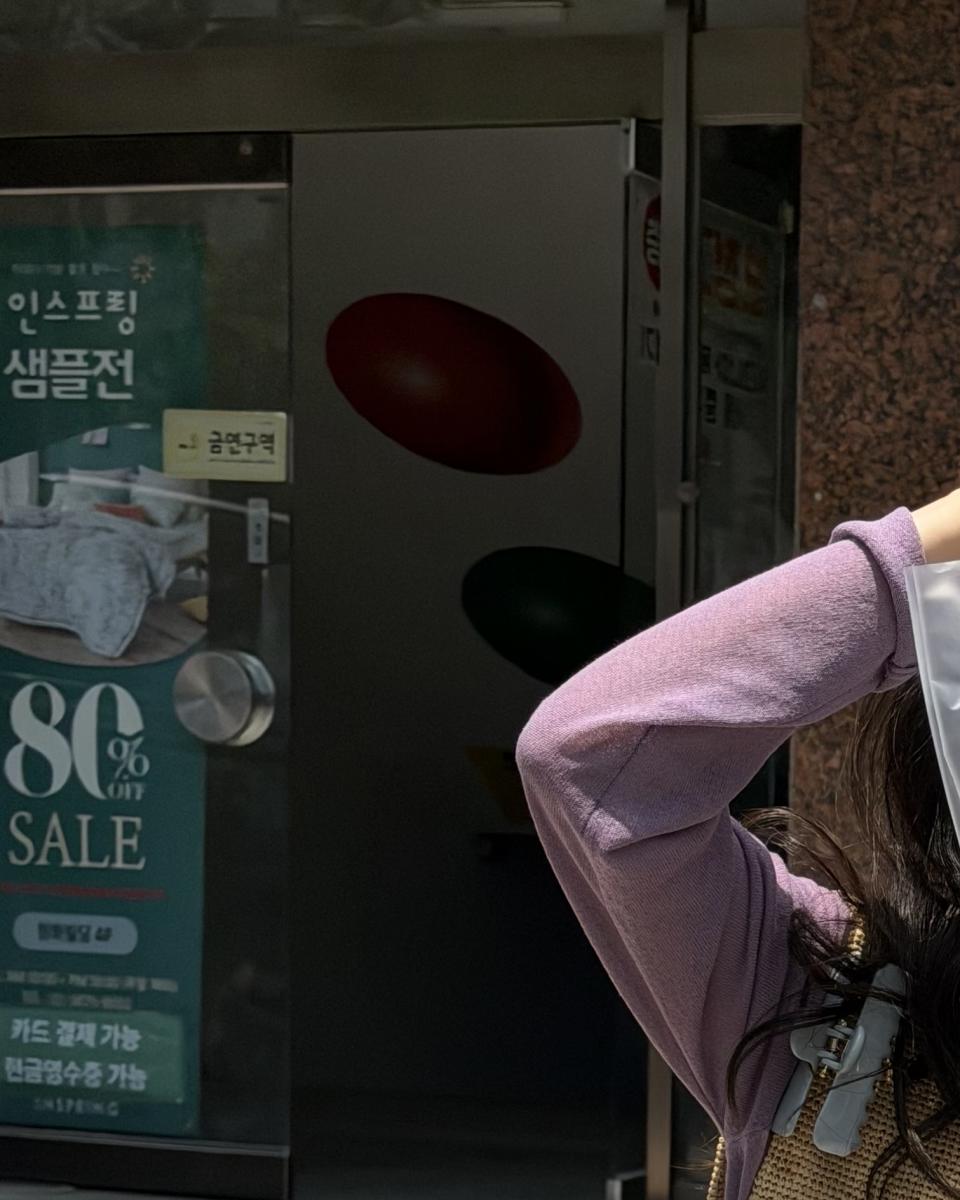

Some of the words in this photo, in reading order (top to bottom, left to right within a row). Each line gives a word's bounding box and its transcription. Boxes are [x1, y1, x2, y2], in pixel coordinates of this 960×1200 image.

[7, 289, 138, 336] 인스프링
[2, 348, 135, 400] 샘플전
[207, 430, 276, 456] 금연구역
[7, 810, 147, 871] SALE
[10, 1017, 52, 1044] 카드
[100, 1023, 142, 1052] 가능
[106, 1063, 148, 1092] 가능
